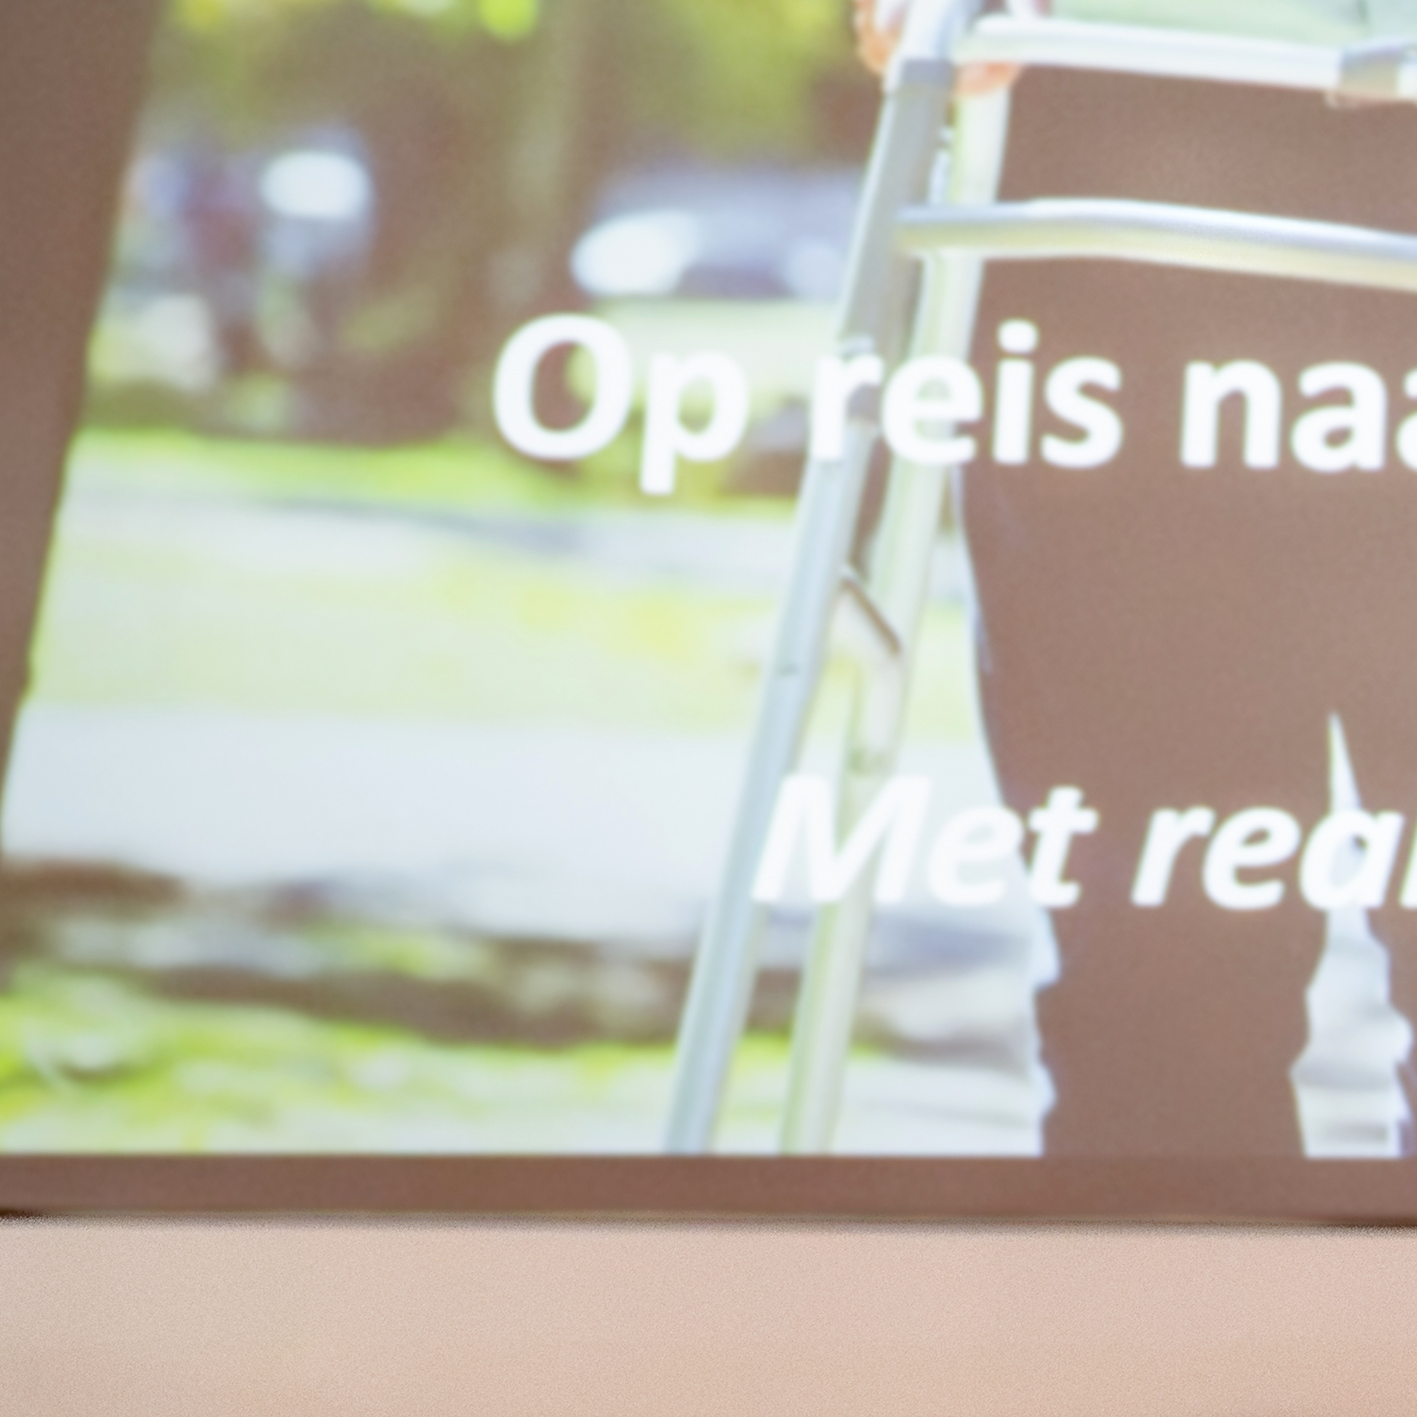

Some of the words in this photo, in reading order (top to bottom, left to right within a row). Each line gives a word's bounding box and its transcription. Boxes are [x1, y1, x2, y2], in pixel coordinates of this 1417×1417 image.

[493, 313, 749, 495] Op
[808, 320, 1124, 469] reis
[750, 775, 1098, 909] Met
